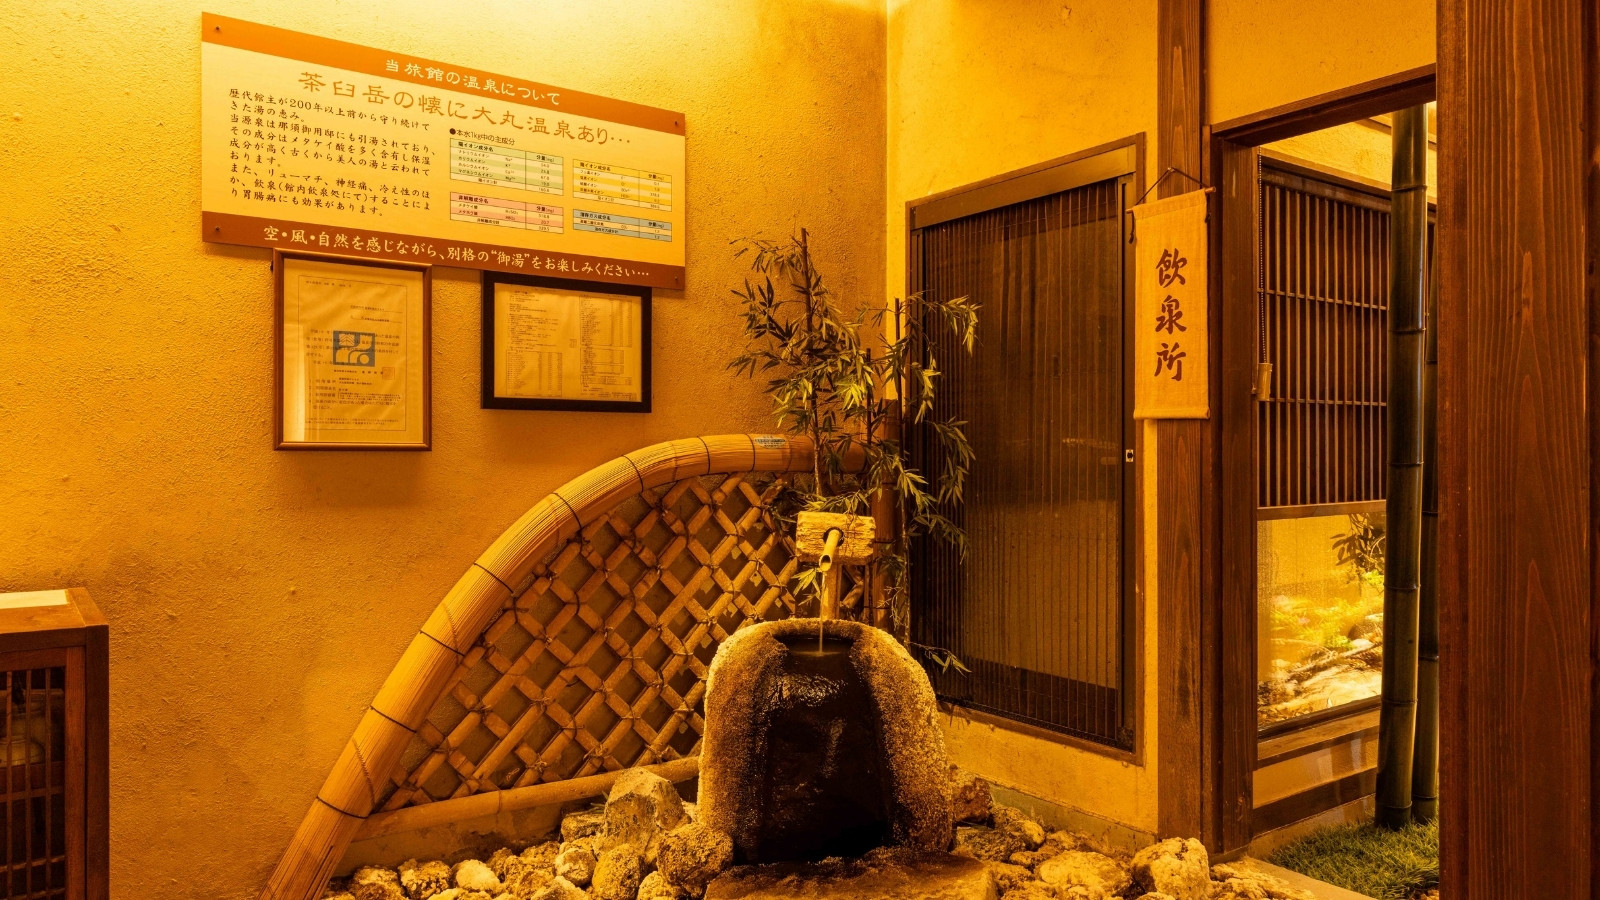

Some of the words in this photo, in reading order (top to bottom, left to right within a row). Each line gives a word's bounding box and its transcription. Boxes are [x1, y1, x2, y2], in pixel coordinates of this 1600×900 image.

[386, 58, 560, 105] 当旅館の温泉について
[229, 88, 430, 131] 歴代館主が200年以上前から守り続けて
[229, 100, 305, 122] きた湯の恵み。
[229, 112, 436, 155] 当源泉は那須御用邸にも引湯されており、
[229, 137, 430, 176] 成分が高く古くから美人の湯と云われて
[229, 150, 281, 167] おります。
[229, 162, 430, 199] また、リューマチ、神経痛、冷え性のほ
[230, 187, 383, 216] り胃腸病にも効果があります。
[1154, 247, 1188, 382] 飲泉所
